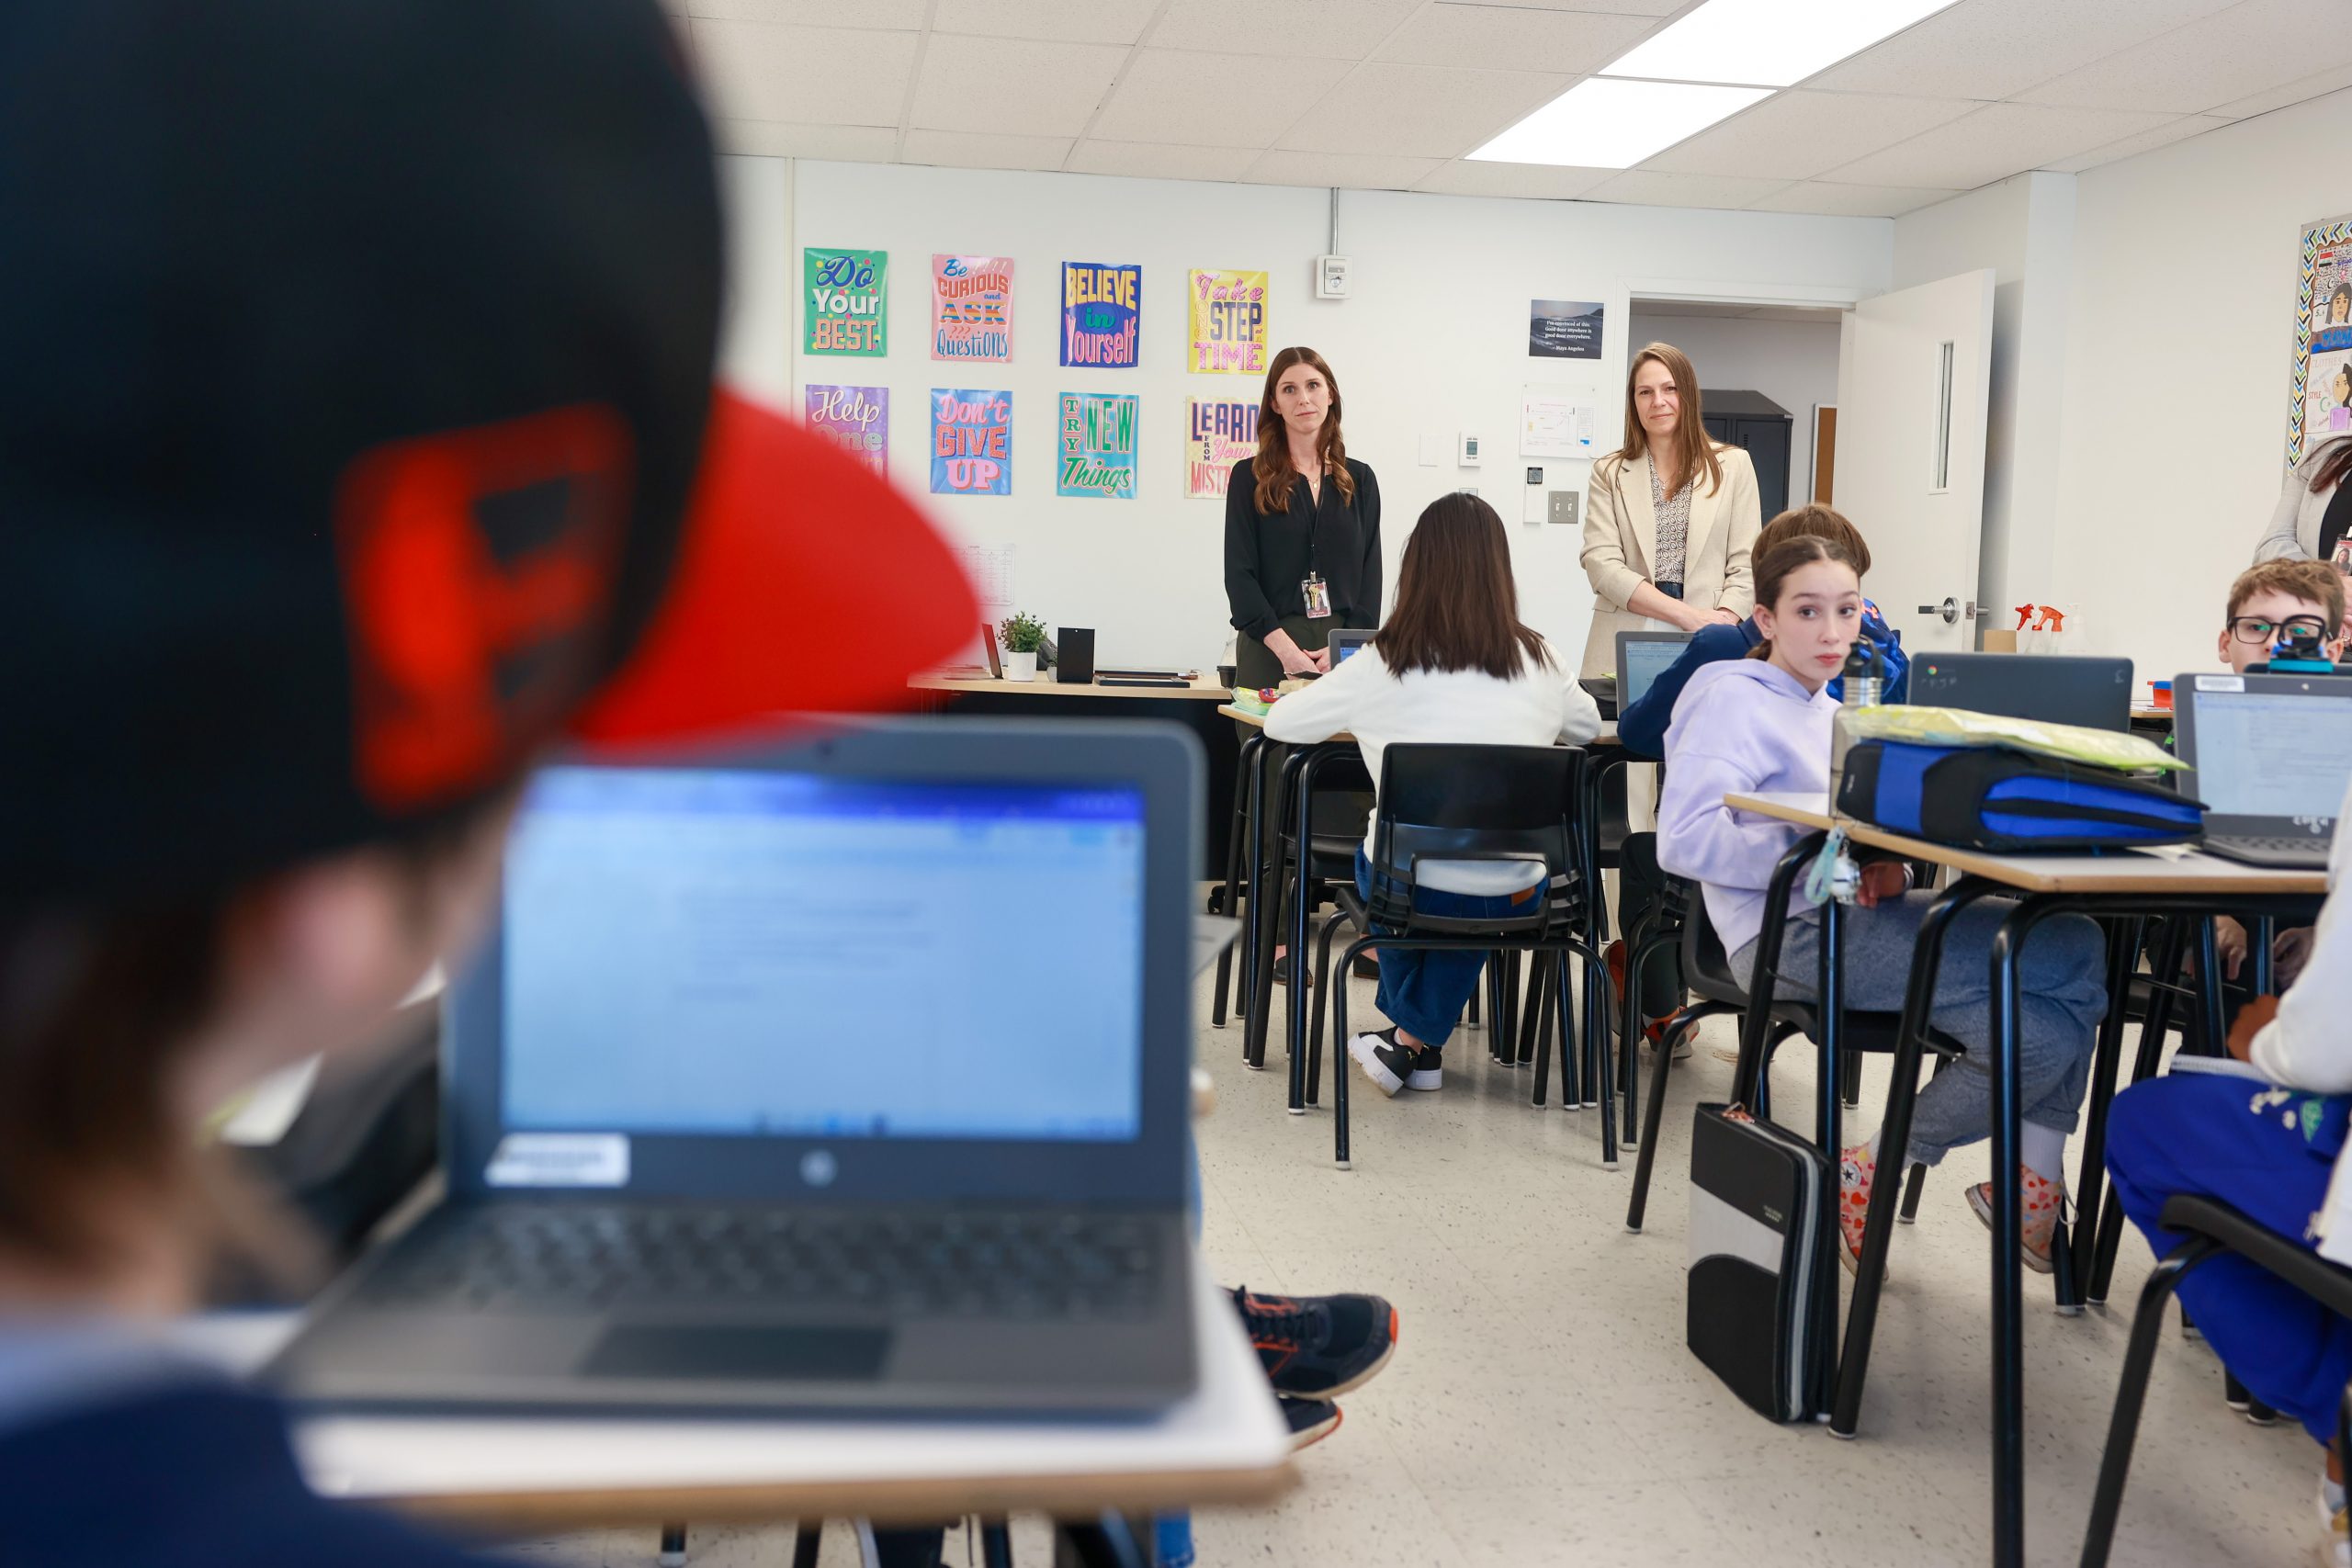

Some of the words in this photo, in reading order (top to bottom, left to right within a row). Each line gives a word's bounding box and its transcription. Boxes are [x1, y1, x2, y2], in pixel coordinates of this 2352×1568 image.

[817, 256, 876, 288] Do
[944, 258, 968, 277] Be
[812, 288, 879, 314] Your
[938, 273, 1009, 299] CURIOUS
[1066, 267, 1136, 310] BELIEVE
[1195, 274, 1263, 301] Take
[940, 299, 1007, 325] ASK
[1085, 308, 1115, 328] in
[1210, 301, 1261, 341] STEP
[817, 319, 877, 351] BEST
[937, 329, 1008, 357] Questions
[1066, 312, 1136, 364] Yourself
[1193, 342, 1263, 370] TIME
[812, 389, 879, 432] Help
[936, 396, 1009, 423] Don't
[2308, 391, 2322, 400] STYLE
[1064, 399, 1081, 453] TRY
[1086, 400, 1134, 452] NEW
[1192, 402, 1260, 442] LEARN
[936, 424, 1007, 458] GIVE
[1212, 438, 1254, 463] Your
[946, 459, 1001, 490] UP
[1063, 457, 1132, 494] Things
